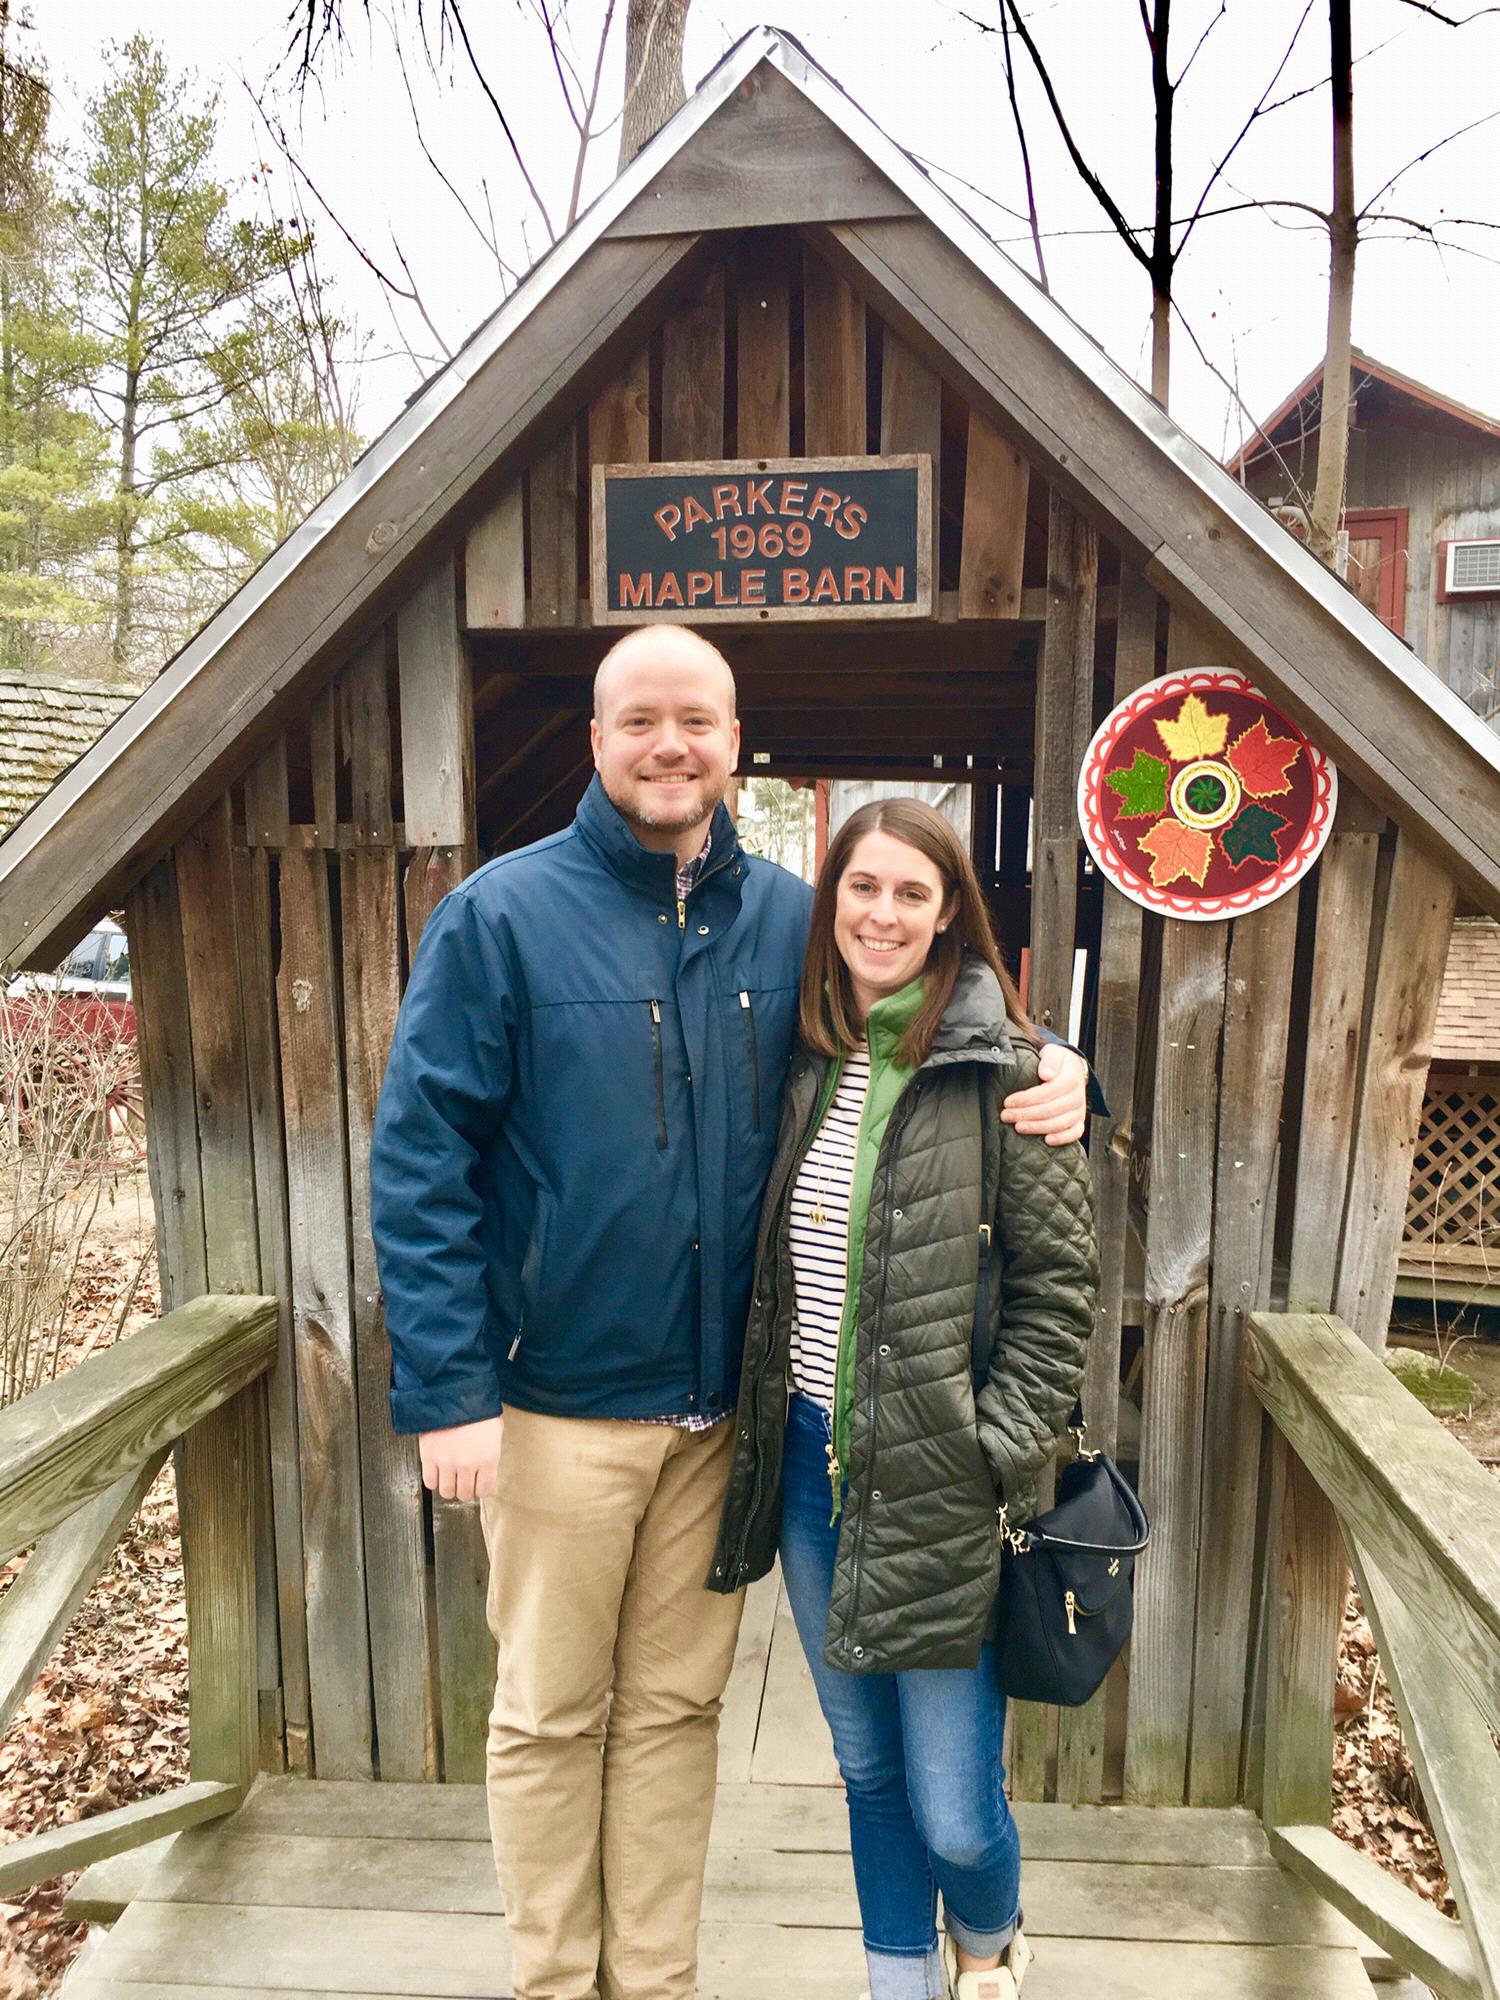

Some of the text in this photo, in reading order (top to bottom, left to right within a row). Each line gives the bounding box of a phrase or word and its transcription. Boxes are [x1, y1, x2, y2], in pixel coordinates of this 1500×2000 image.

[653, 479, 868, 542] PARKER'S
[711, 521, 811, 560] 1969
[619, 566, 904, 607] MAPLE BARN
